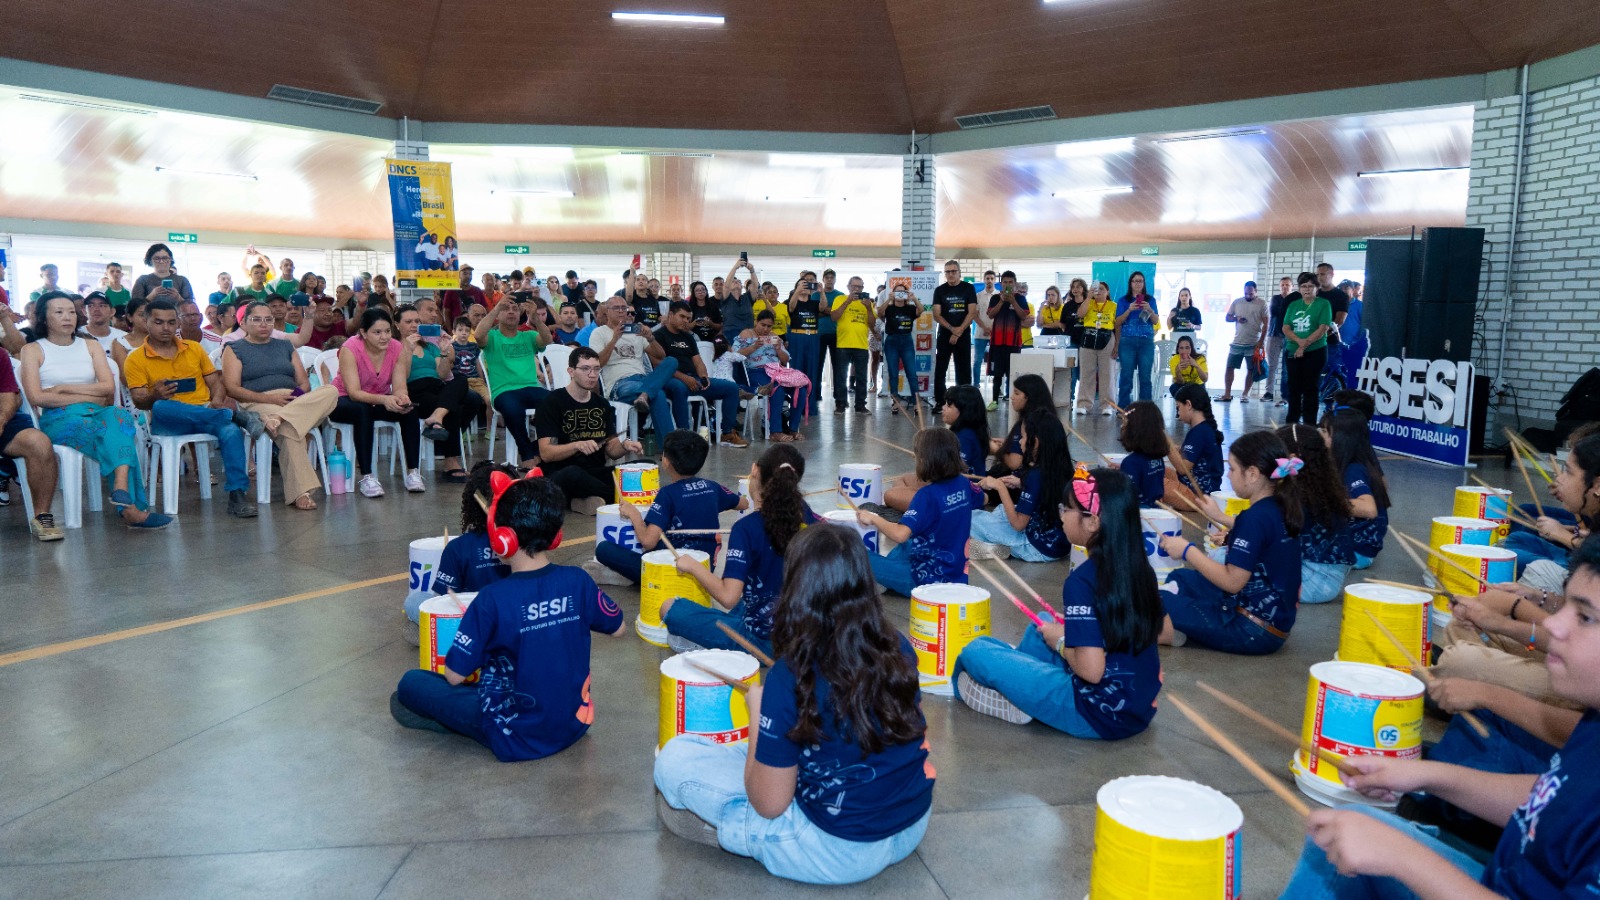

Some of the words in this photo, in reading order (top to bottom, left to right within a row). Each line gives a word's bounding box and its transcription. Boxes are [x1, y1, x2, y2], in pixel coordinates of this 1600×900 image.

[389, 164, 416, 175] DNCS
[423, 202, 444, 210] Brasil
[1355, 356, 1467, 427] #SESI
[1367, 420, 1396, 436] UTURO
[1397, 423, 1410, 439] DO
[1410, 426, 1460, 448] TRABALHO
[946, 489, 965, 506] SESI
[1234, 537, 1249, 548] ESI
[527, 596, 568, 621] SESI
[1066, 605, 1092, 615] SESI
[454, 630, 473, 647] ESI
[1380, 729, 1398, 741] 50
